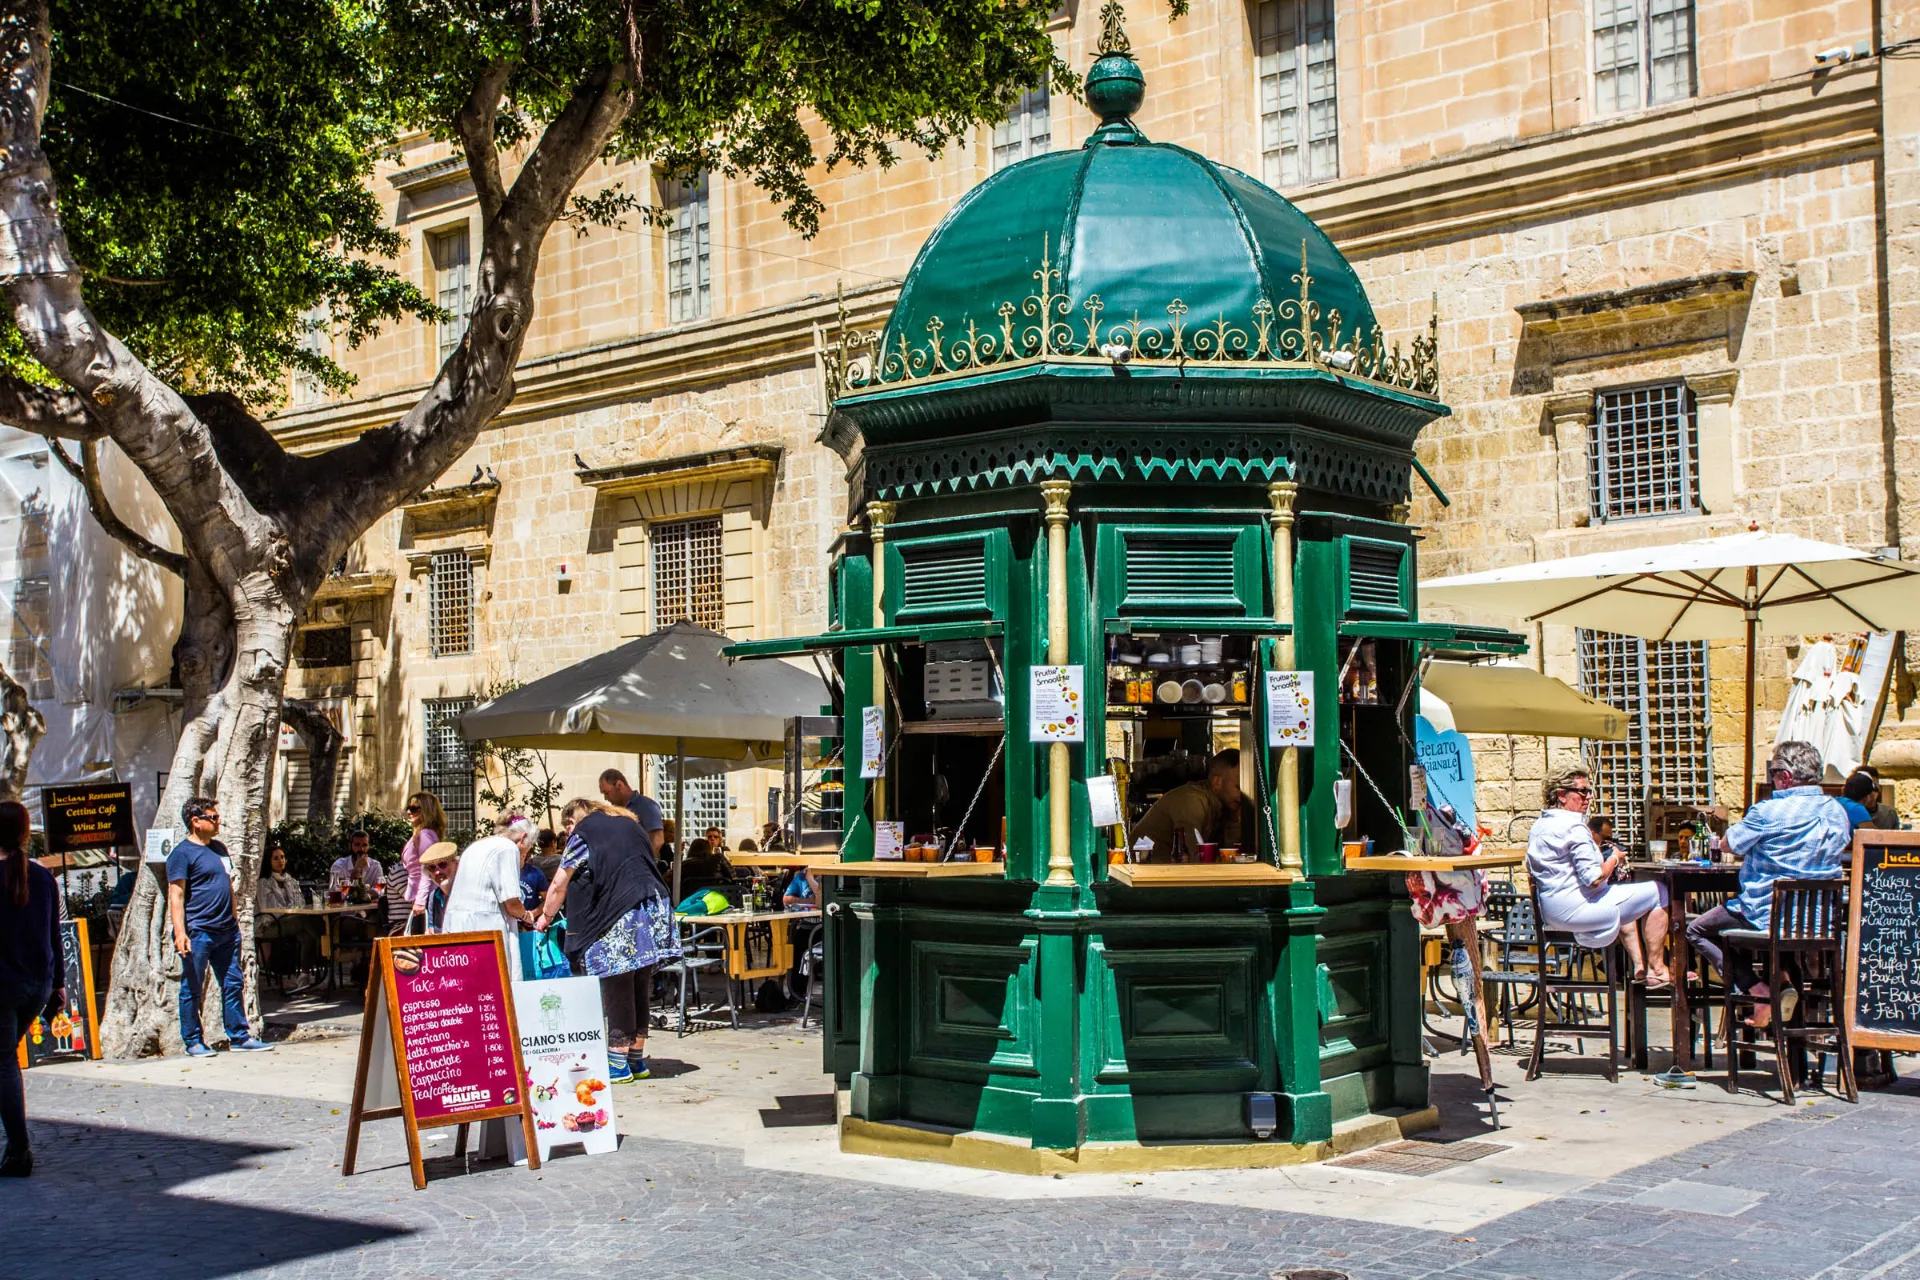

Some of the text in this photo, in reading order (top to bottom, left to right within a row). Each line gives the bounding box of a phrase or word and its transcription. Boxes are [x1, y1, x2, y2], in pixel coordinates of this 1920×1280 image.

[88, 791, 126, 801] Restaurant
[66, 807, 97, 817] Cettina
[73, 822, 112, 832] Wine Bar
[1870, 888, 1914, 902] Snails
[1870, 938, 1912, 959] Chef's
[421, 950, 469, 974] Luciano
[1869, 954, 1908, 974] Stuffed
[1873, 1001, 1904, 1020] Fish
[406, 1032, 450, 1047] Americano
[567, 1029, 602, 1043] KIOSK
[409, 1060, 425, 1075] Hot
[410, 1066, 462, 1088] Cappuccino
[441, 1089, 491, 1105] MAURO
